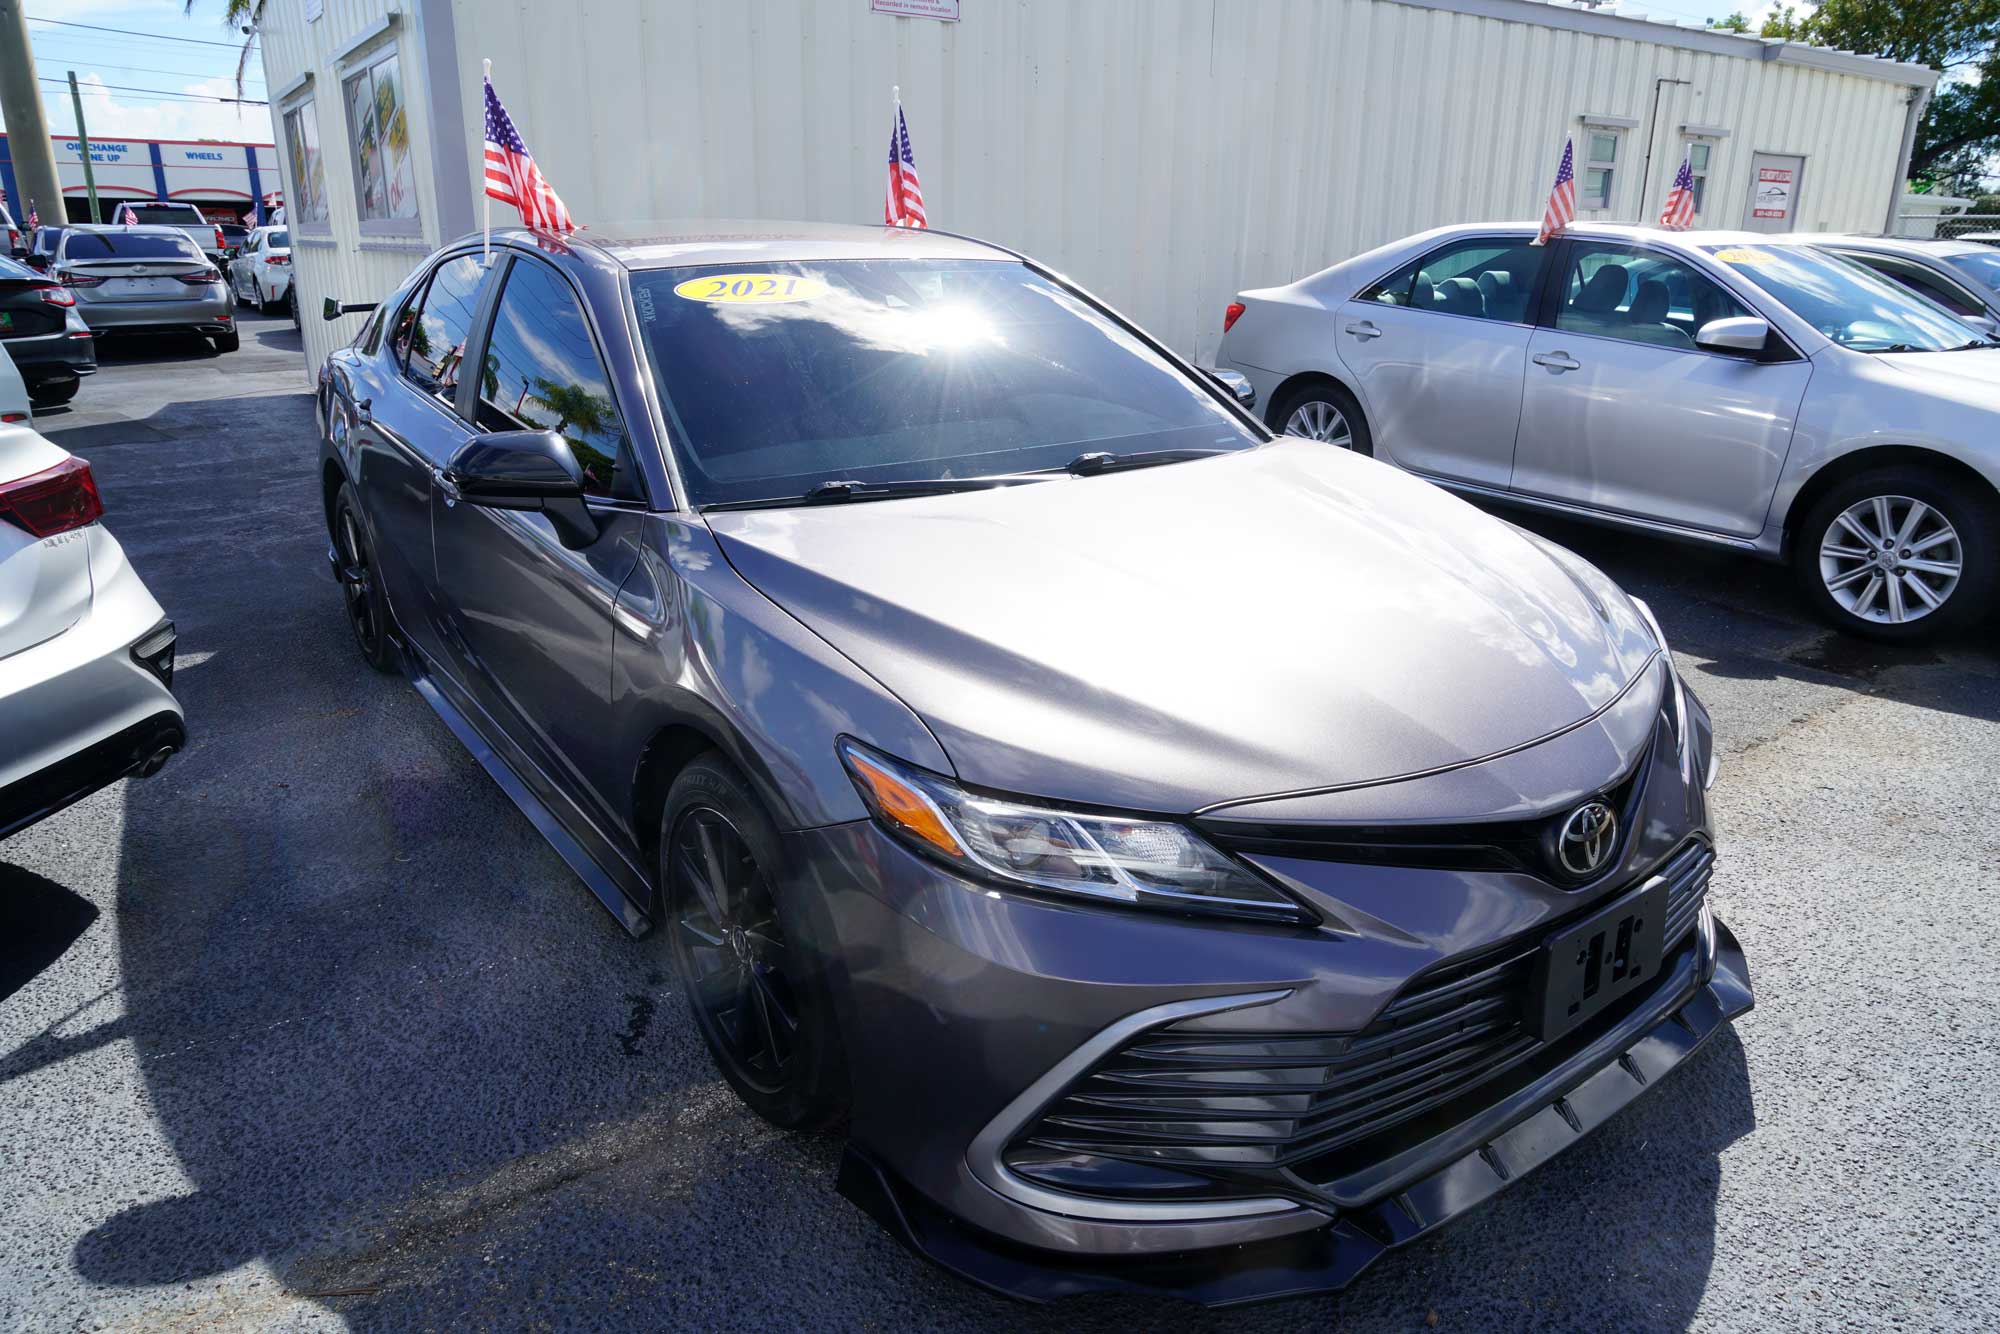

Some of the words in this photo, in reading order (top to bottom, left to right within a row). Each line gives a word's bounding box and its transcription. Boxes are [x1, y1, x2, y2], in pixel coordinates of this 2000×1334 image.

[77, 153, 105, 162] TNE
[107, 153, 121, 162] UP
[184, 151, 223, 161] WHEELS
[705, 279, 798, 298] 2021
